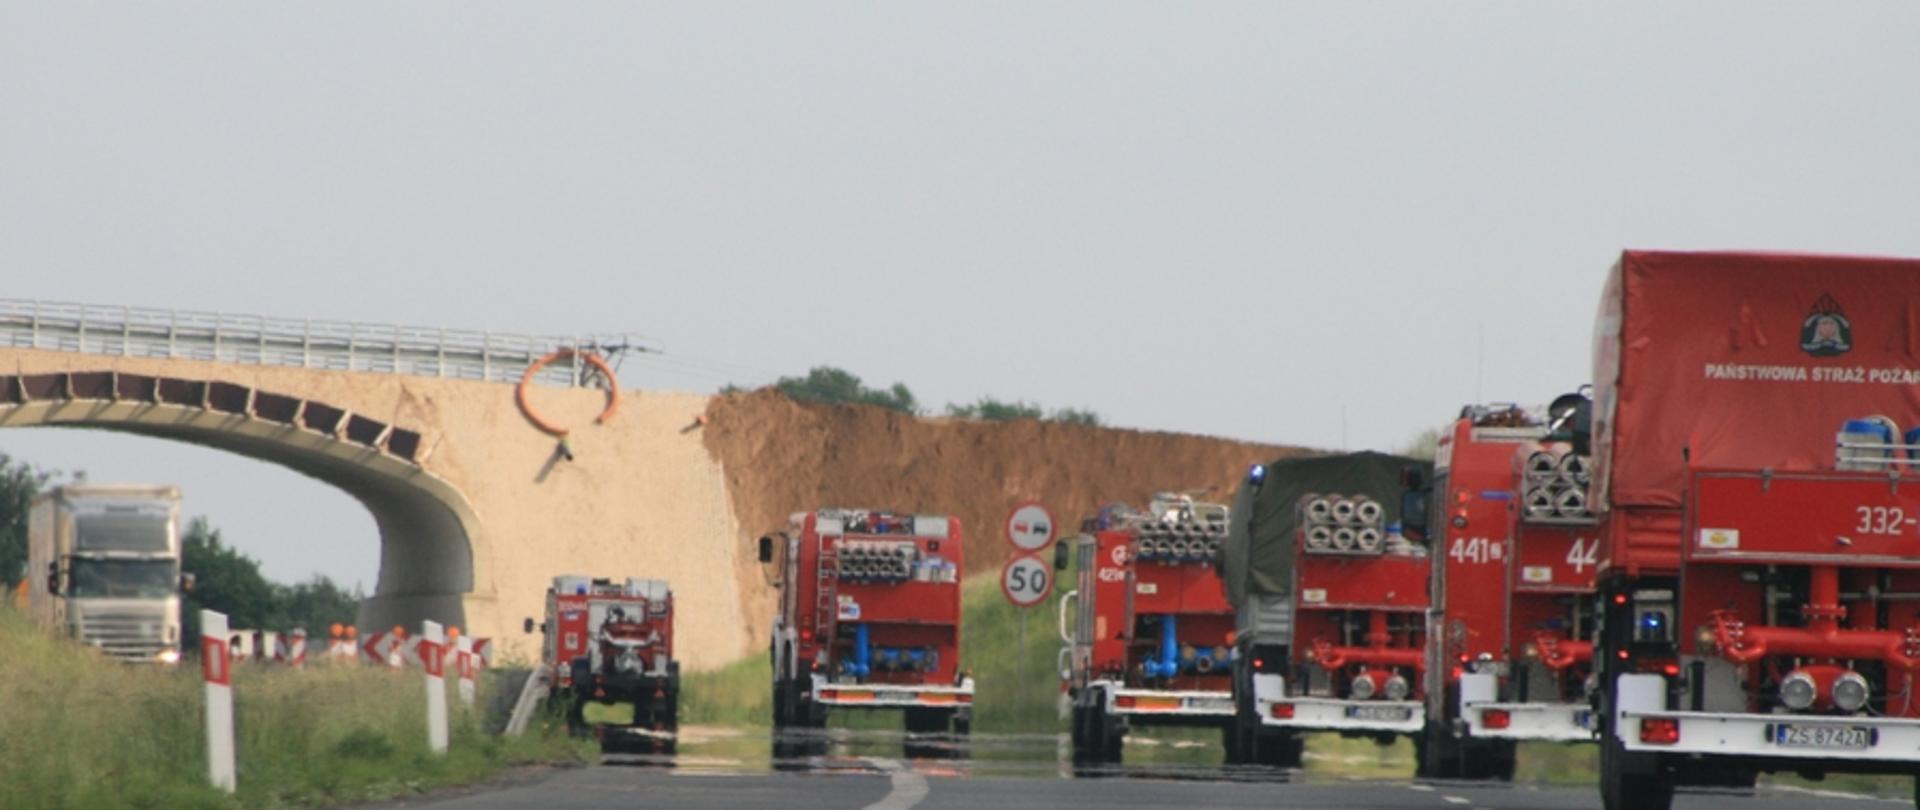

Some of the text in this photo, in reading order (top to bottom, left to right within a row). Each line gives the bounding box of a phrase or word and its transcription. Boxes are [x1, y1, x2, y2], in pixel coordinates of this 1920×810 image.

[1705, 363, 1807, 381] PAŃSTWOWA
[1812, 366, 1865, 383] STRAŻ
[1010, 566, 1046, 594] 50
